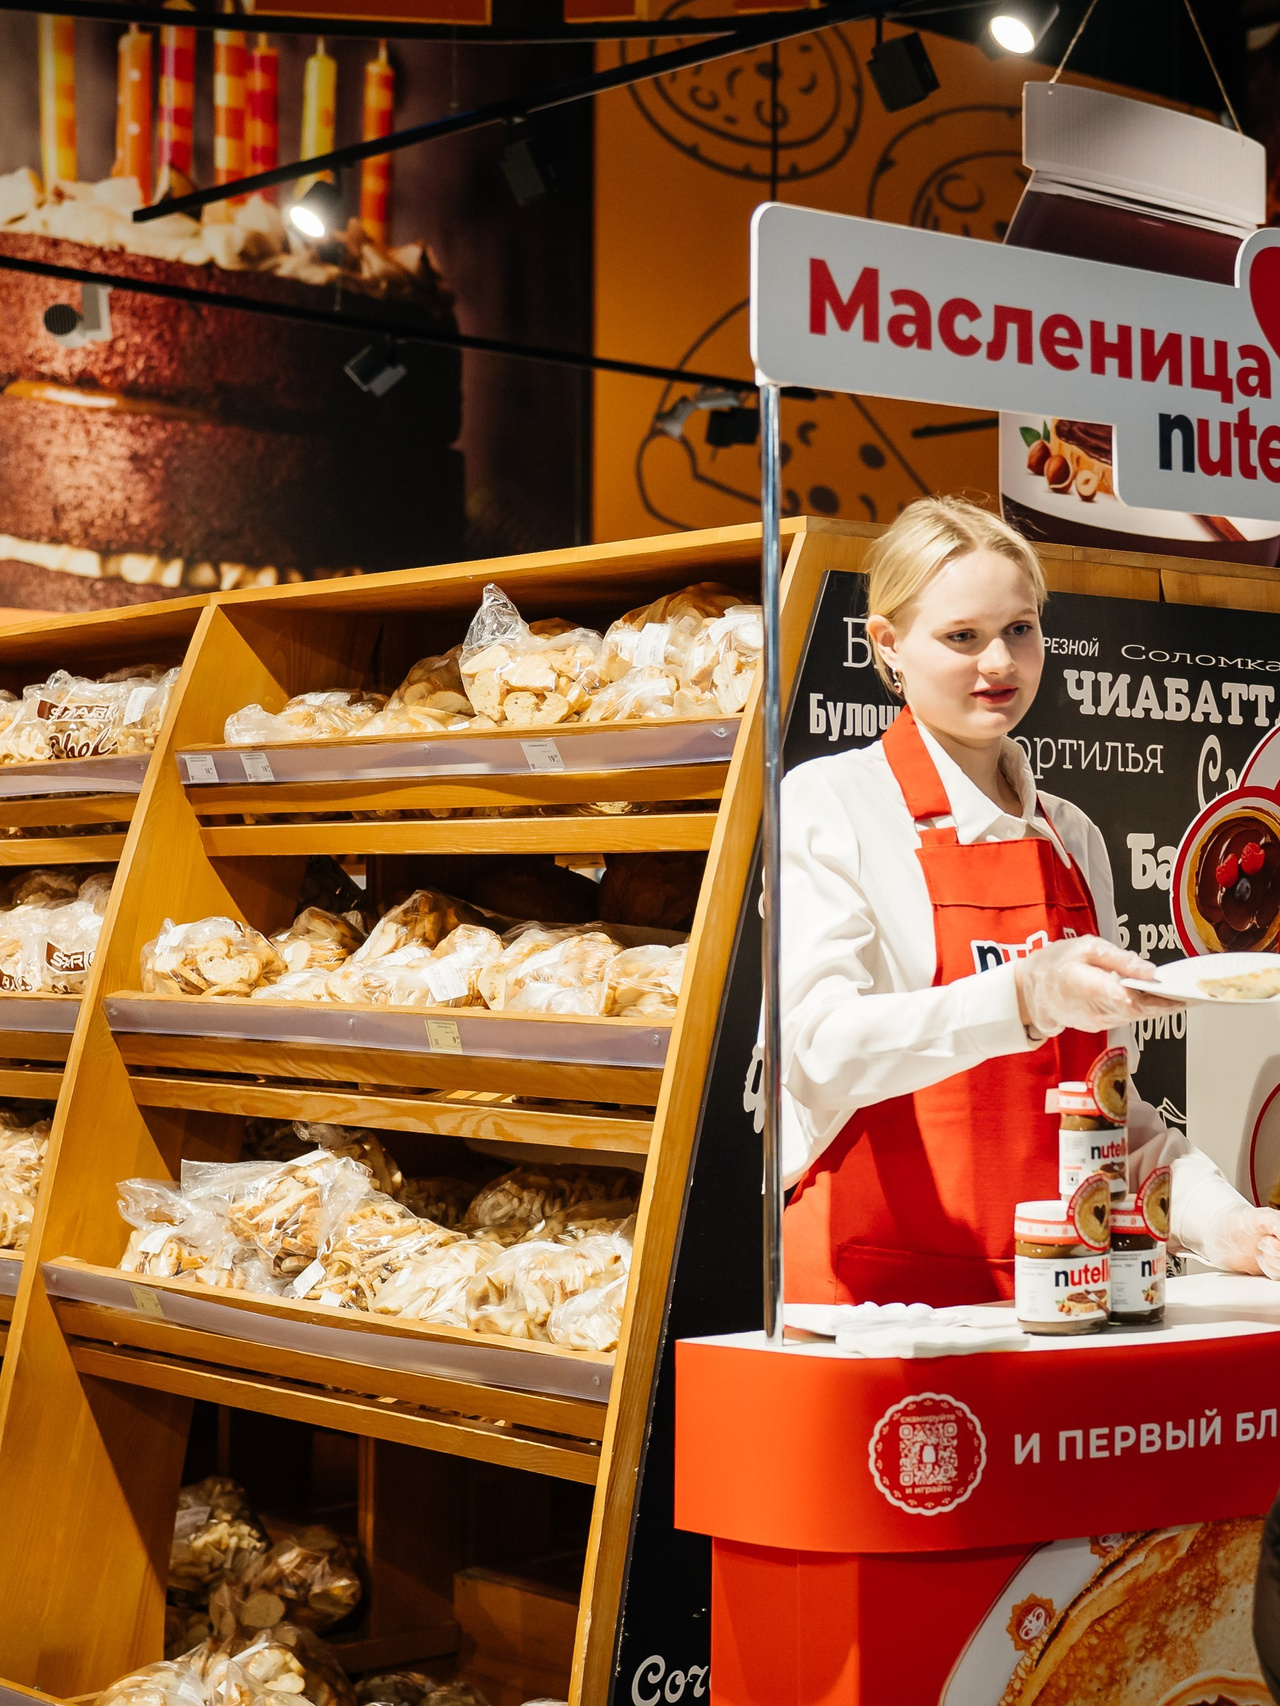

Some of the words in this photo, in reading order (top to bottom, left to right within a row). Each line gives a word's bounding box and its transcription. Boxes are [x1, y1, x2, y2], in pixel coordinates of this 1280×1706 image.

[808, 257, 1272, 404] Масленица
[1043, 637, 1099, 657] РЕЗНОЙ
[809, 693, 901, 741] Булоч
[1008, 734, 1164, 780] ортилья
[1127, 833, 1178, 889] Ба
[1138, 923, 1183, 960] рж
[1014, 1433, 1041, 1465] И
[1059, 1408, 1222, 1461] ПЕРВЫЙ
